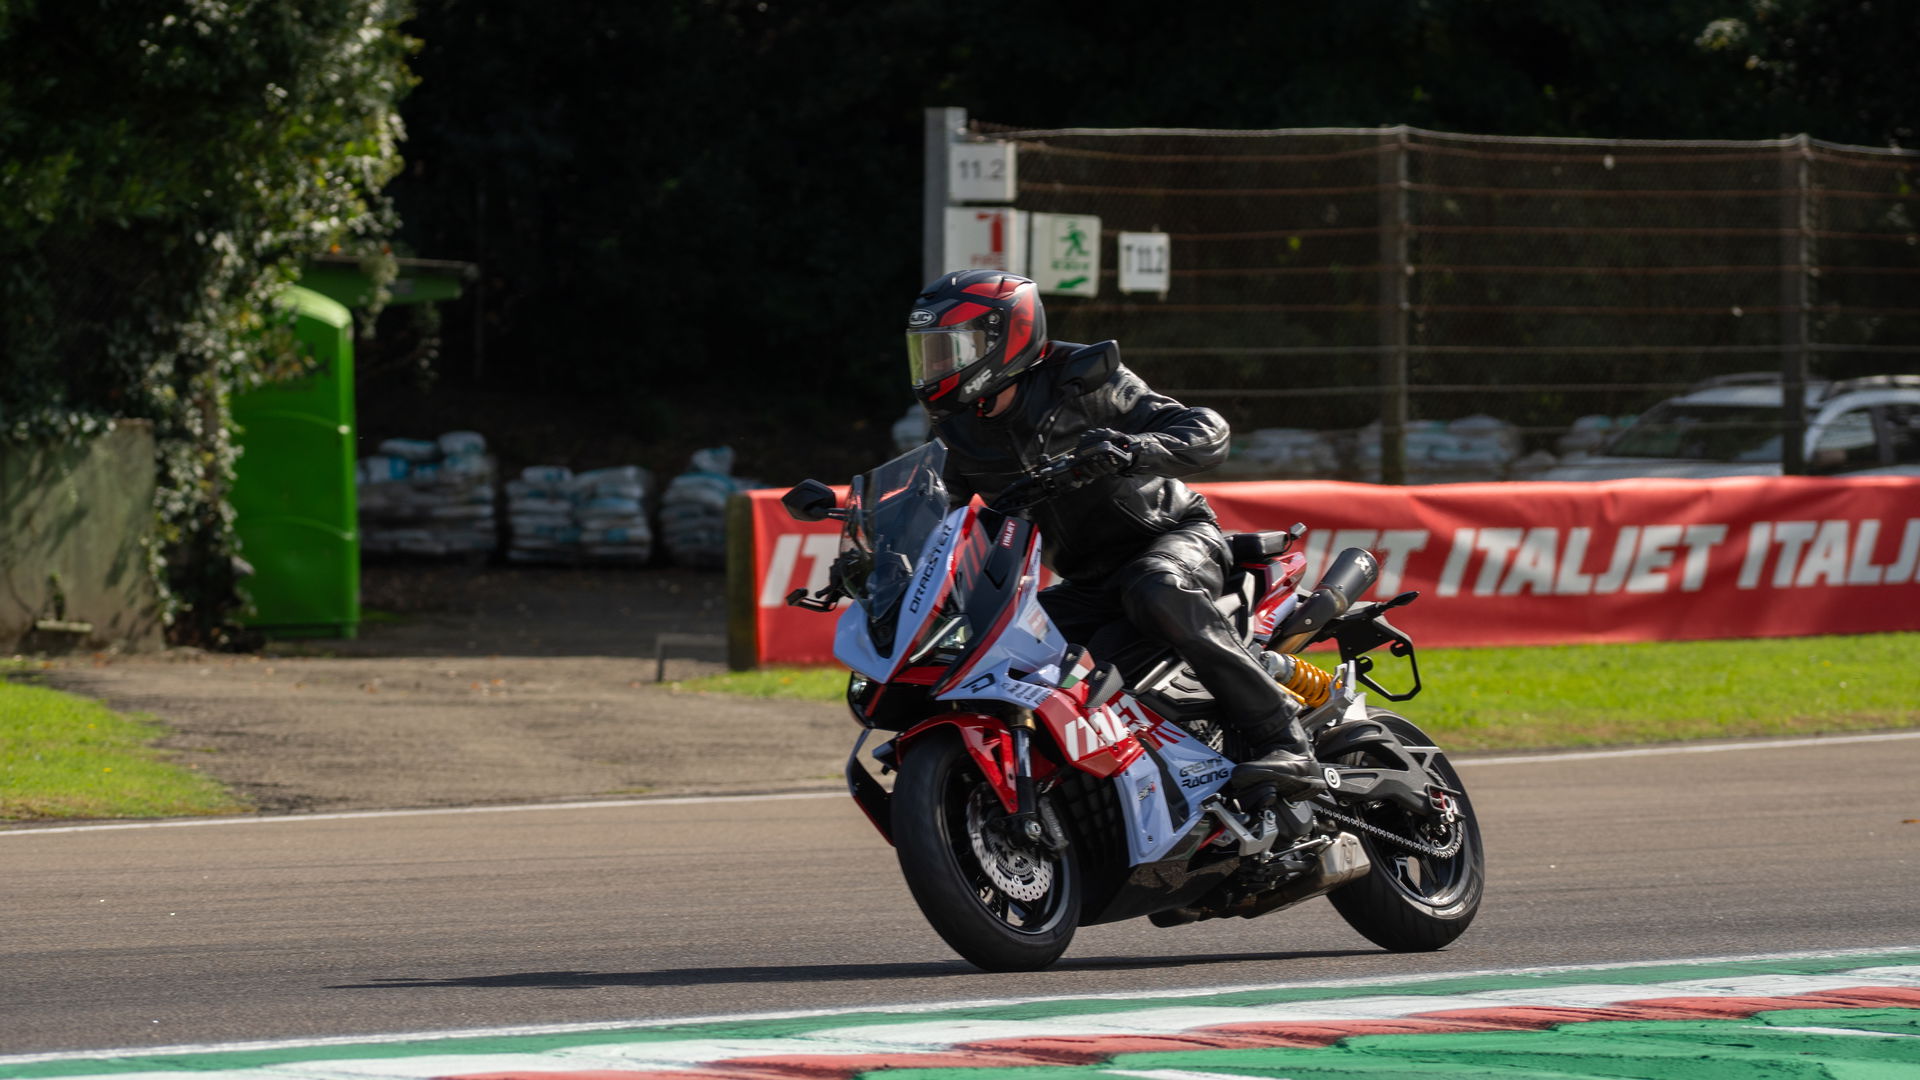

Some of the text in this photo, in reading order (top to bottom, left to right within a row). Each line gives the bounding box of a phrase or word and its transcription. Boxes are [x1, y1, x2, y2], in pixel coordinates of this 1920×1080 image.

[909, 525, 952, 614] DRAGSTER
[1436, 525, 1728, 597] ITALJET
[1737, 519, 1920, 590] ITALJ
